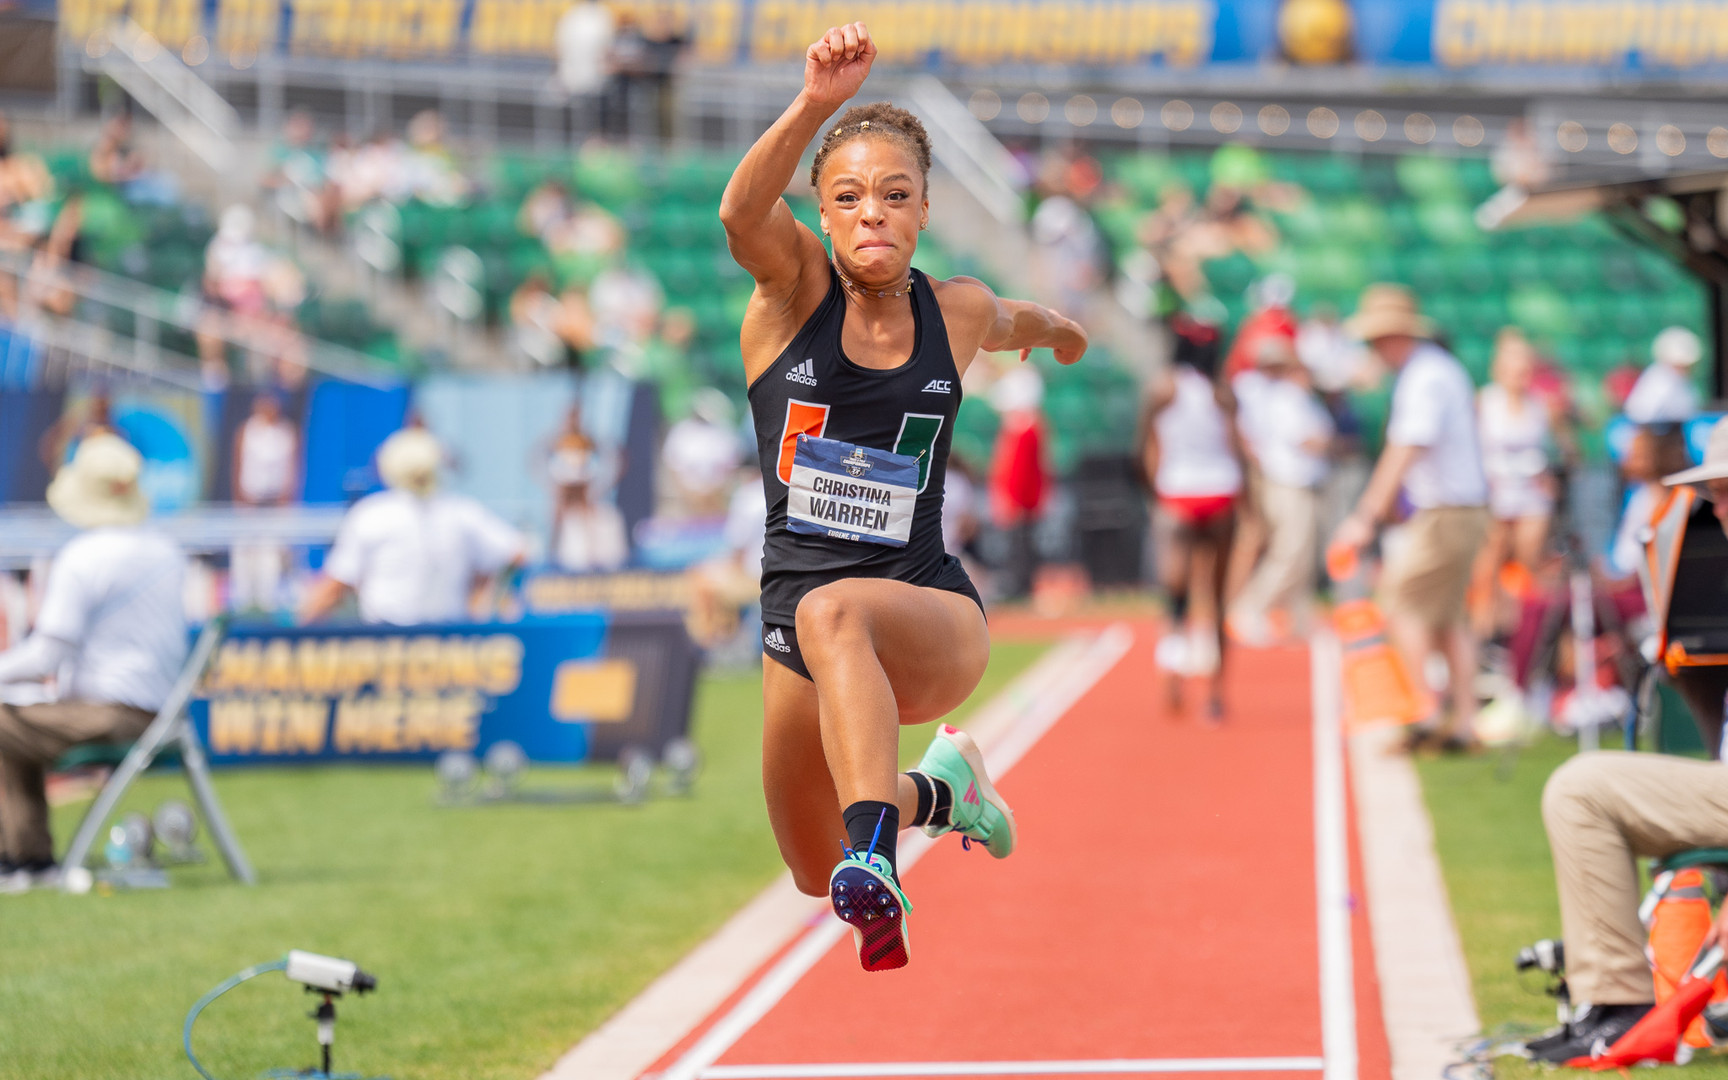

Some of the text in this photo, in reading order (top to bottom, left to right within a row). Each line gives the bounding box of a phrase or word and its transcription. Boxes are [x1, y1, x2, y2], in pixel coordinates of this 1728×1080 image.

[785, 371, 818, 387] adidas
[923, 379, 952, 392] ACC
[813, 476, 891, 506] CHRISTINA
[810, 496, 890, 531] WARREN
[764, 635, 791, 653] adidas
